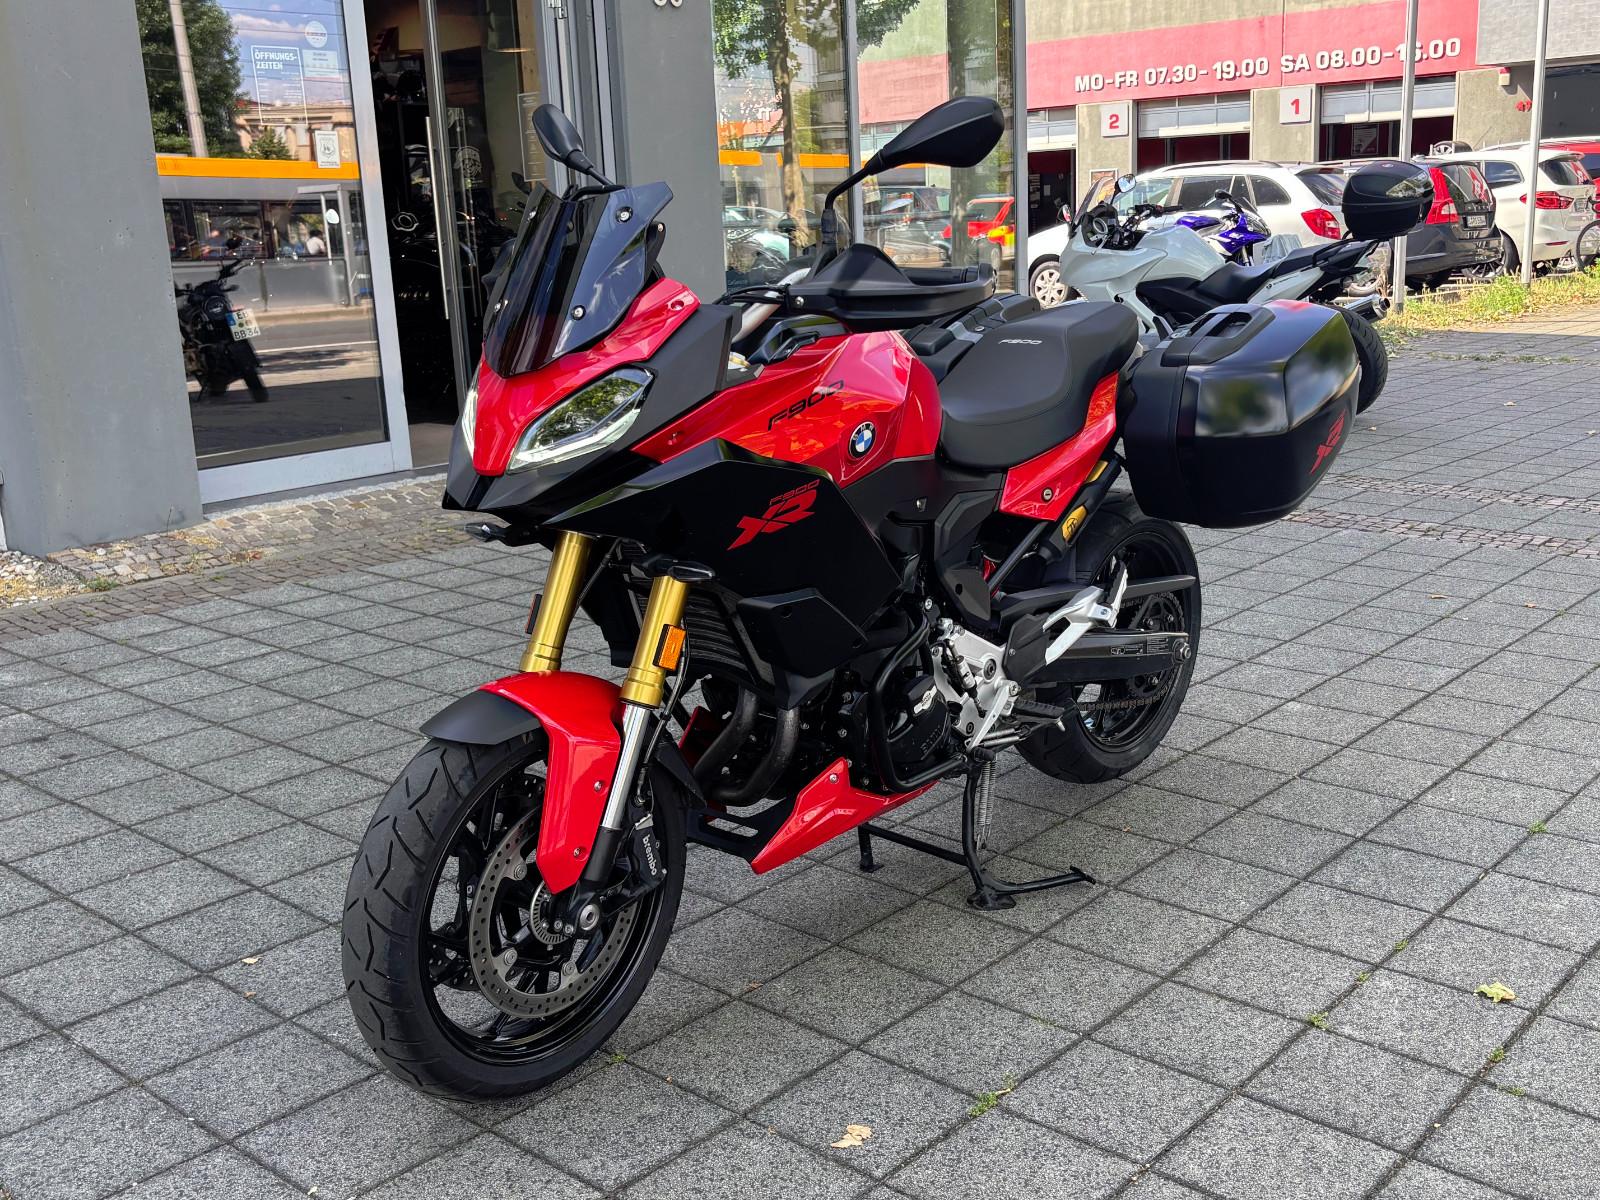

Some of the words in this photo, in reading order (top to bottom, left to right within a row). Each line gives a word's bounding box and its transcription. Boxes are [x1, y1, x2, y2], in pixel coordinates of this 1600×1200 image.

[254, 50, 297, 61] ÖFFNUNGS-
[256, 61, 283, 70] ZEITEN
[1280, 53, 1310, 73] SA
[1075, 70, 1138, 92] MO-FR
[1290, 98, 1301, 115] 1
[1109, 114, 1120, 129] 2
[767, 380, 844, 431] F900
[727, 489, 817, 551] XR
[642, 833, 658, 876] brembo
